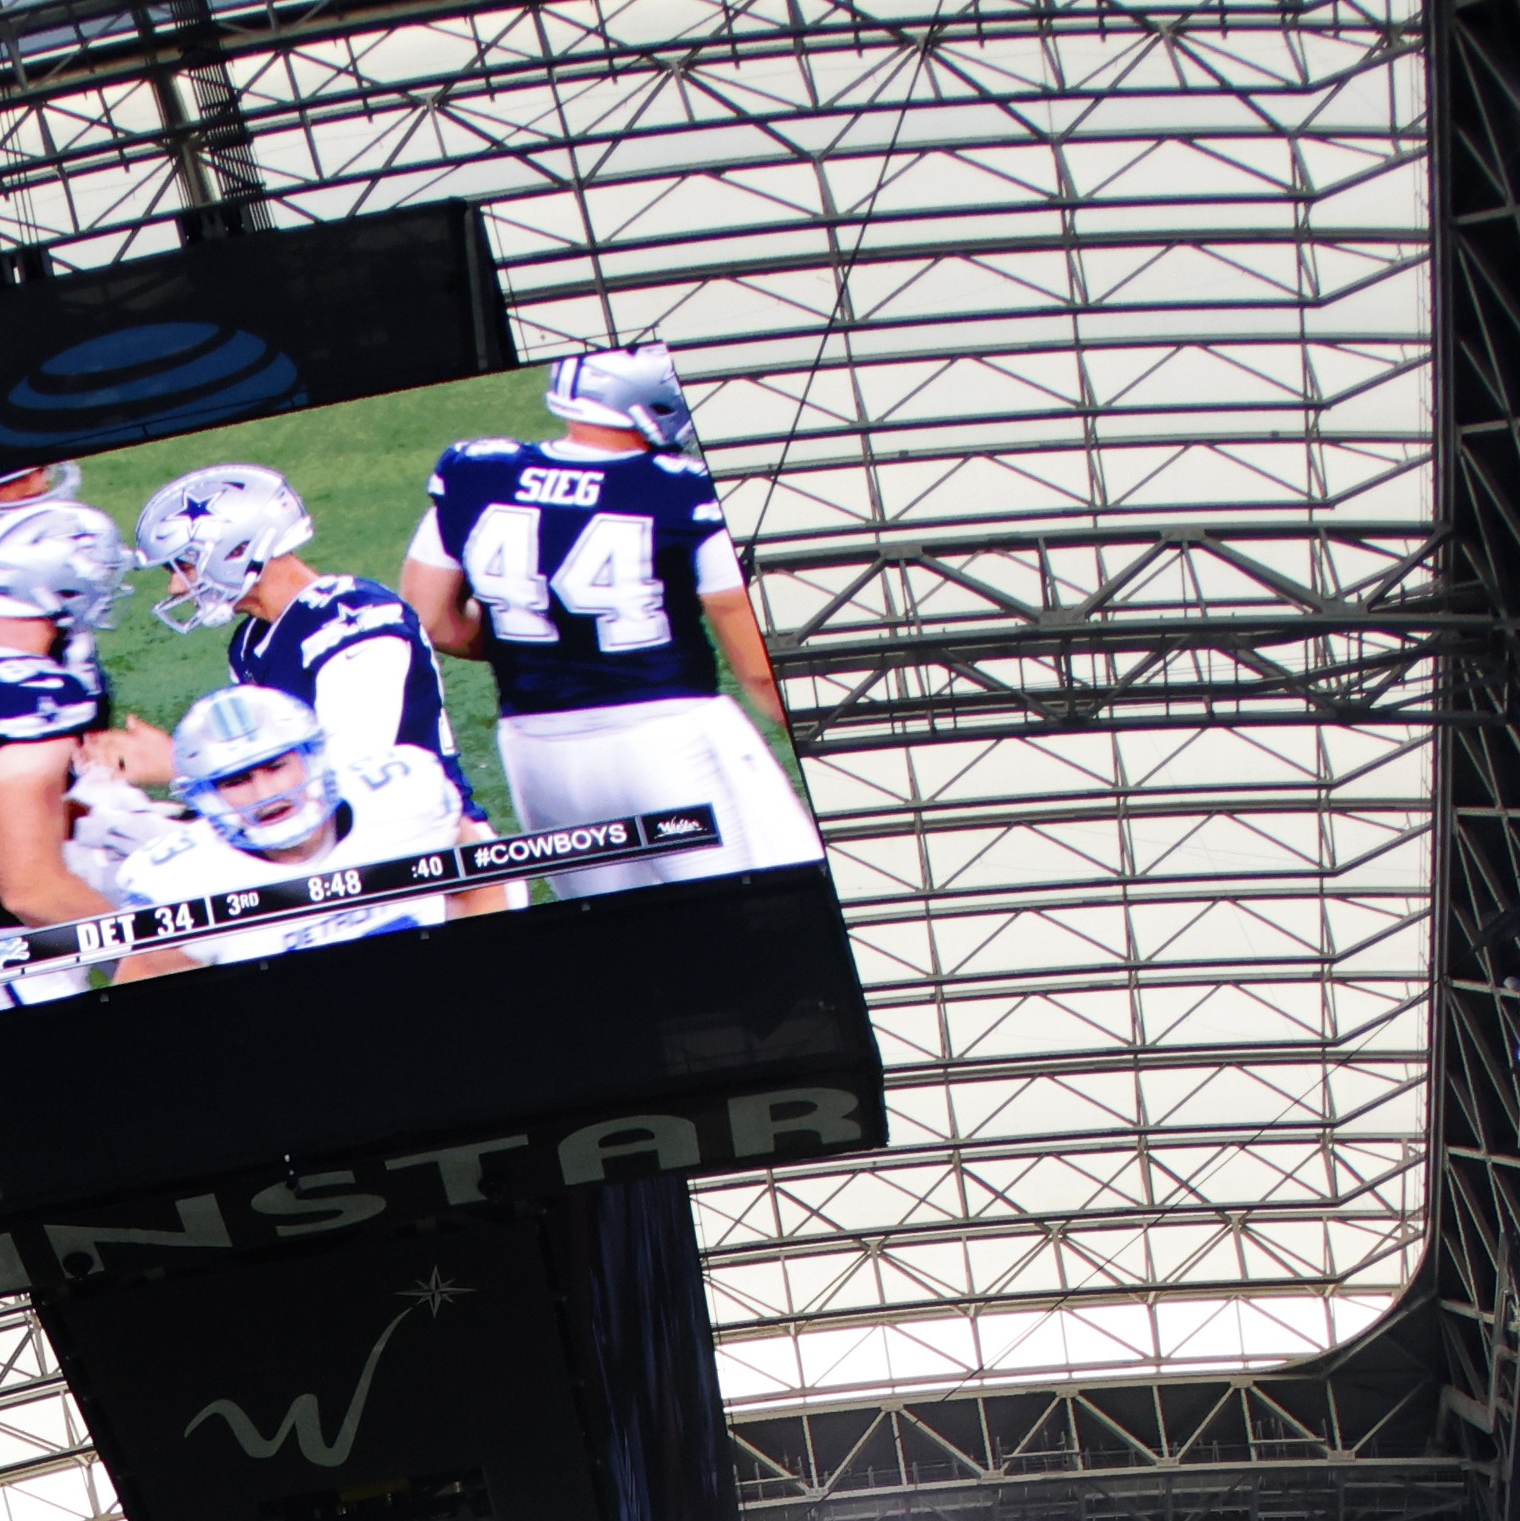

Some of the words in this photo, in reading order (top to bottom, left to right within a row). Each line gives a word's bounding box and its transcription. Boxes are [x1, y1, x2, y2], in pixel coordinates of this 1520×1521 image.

[515, 467, 604, 506] SIEG
[463, 503, 672, 652] 44
[474, 823, 626, 868] #COWBOYS
[226, 891, 259, 917] 3RD
[308, 869, 361, 902] 8:48
[412, 856, 444, 879] :40
[76, 914, 136, 953] DET
[154, 903, 195, 938] 34
